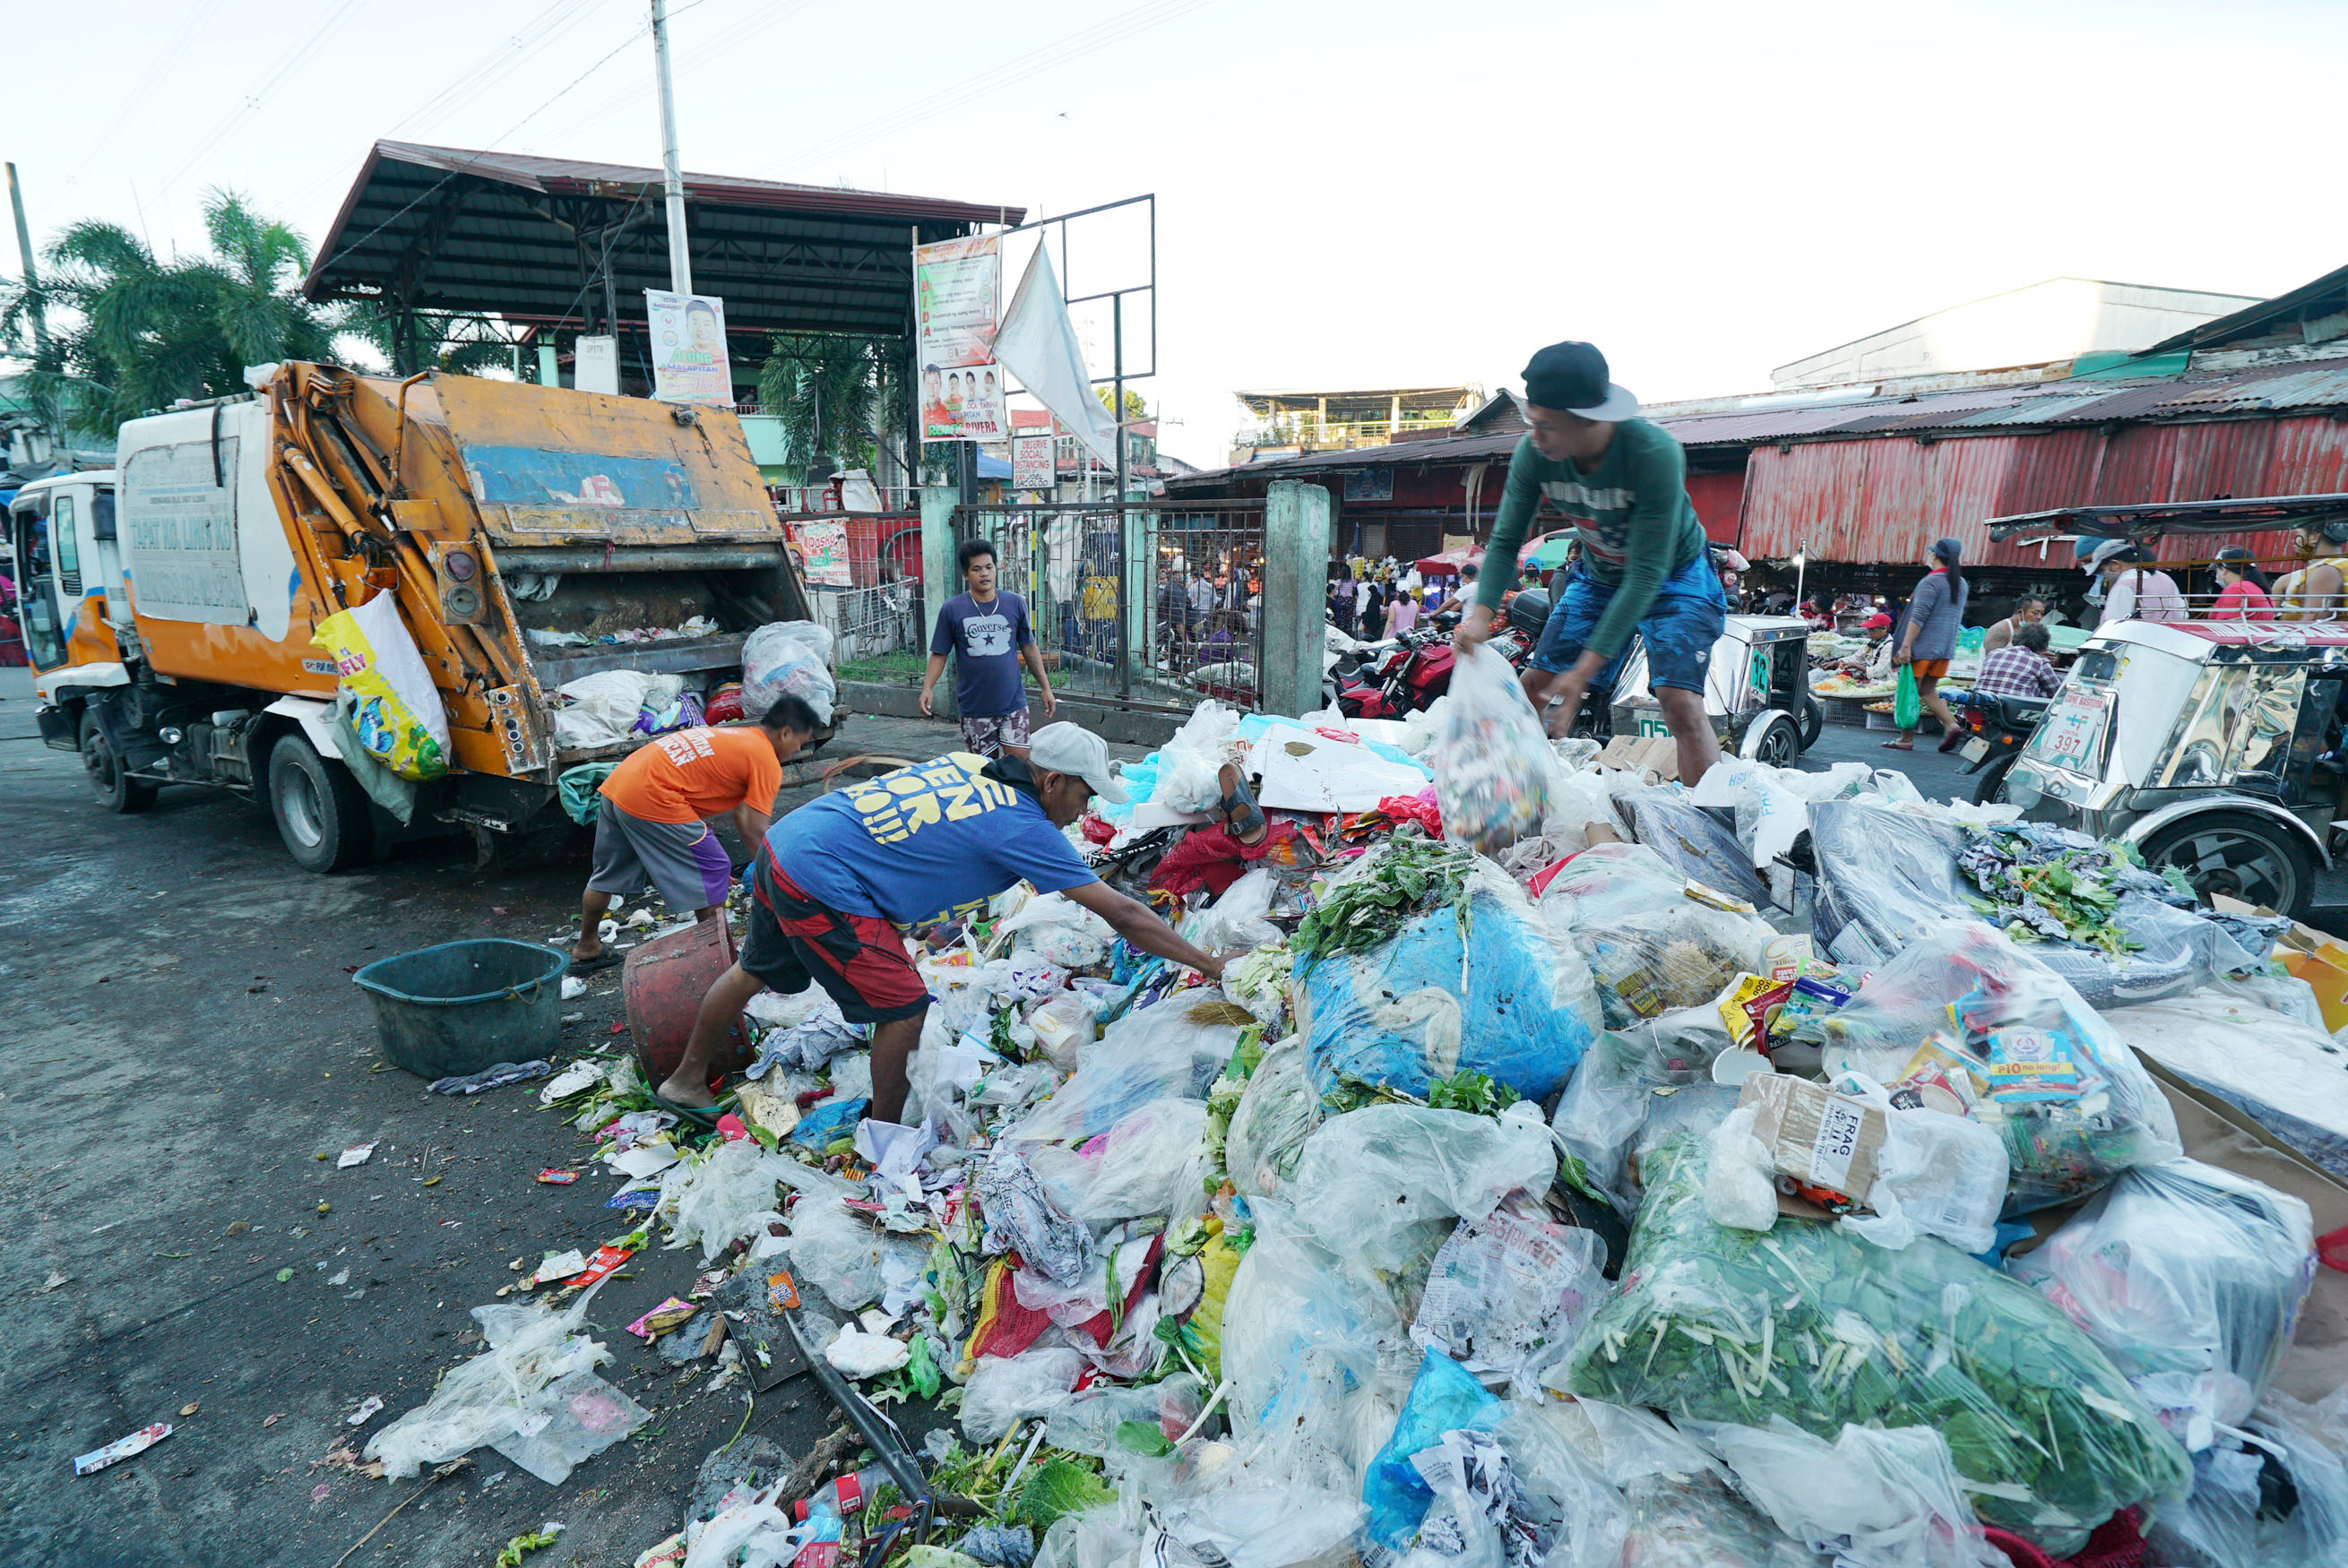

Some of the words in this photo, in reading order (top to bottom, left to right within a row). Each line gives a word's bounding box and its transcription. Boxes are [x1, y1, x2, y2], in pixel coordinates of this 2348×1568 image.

[965, 421, 998, 435] RIVERA
[1022, 440, 1048, 449] OBSERVE
[1020, 450, 1044, 459] SOCIAL
[1014, 460, 1049, 470] DISTANCING
[1014, 479, 1048, 487] BACOLOD
[967, 622, 1009, 639] Converse
[1753, 653, 1766, 691] 12
[2054, 735, 2081, 754] 397
[842, 780, 910, 846] KO!!!
